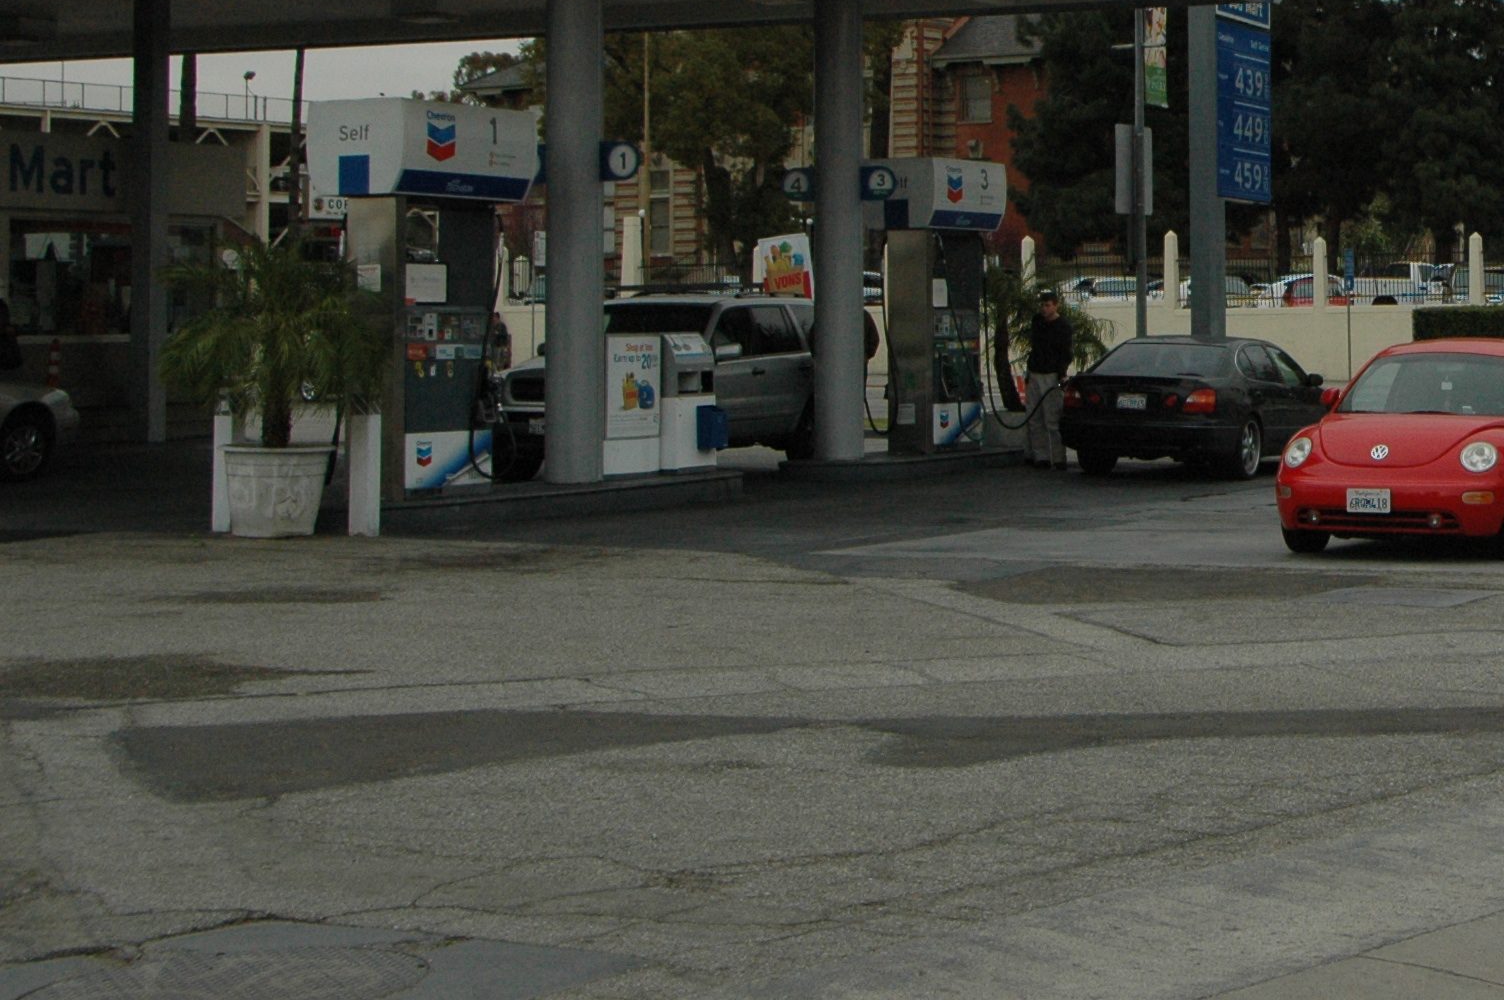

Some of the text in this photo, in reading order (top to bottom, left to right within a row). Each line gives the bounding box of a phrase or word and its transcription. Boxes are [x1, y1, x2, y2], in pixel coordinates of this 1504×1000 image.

[1235, 67, 1263, 96] 439
[339, 124, 370, 141] Self
[490, 117, 497, 145] 1
[1233, 114, 1263, 143] 449
[10, 143, 117, 198] Mart
[619, 151, 626, 170] 1
[790, 177, 802, 191] 4
[877, 173, 885, 187] 3
[980, 168, 989, 190] 3
[1234, 162, 1262, 191] 459
